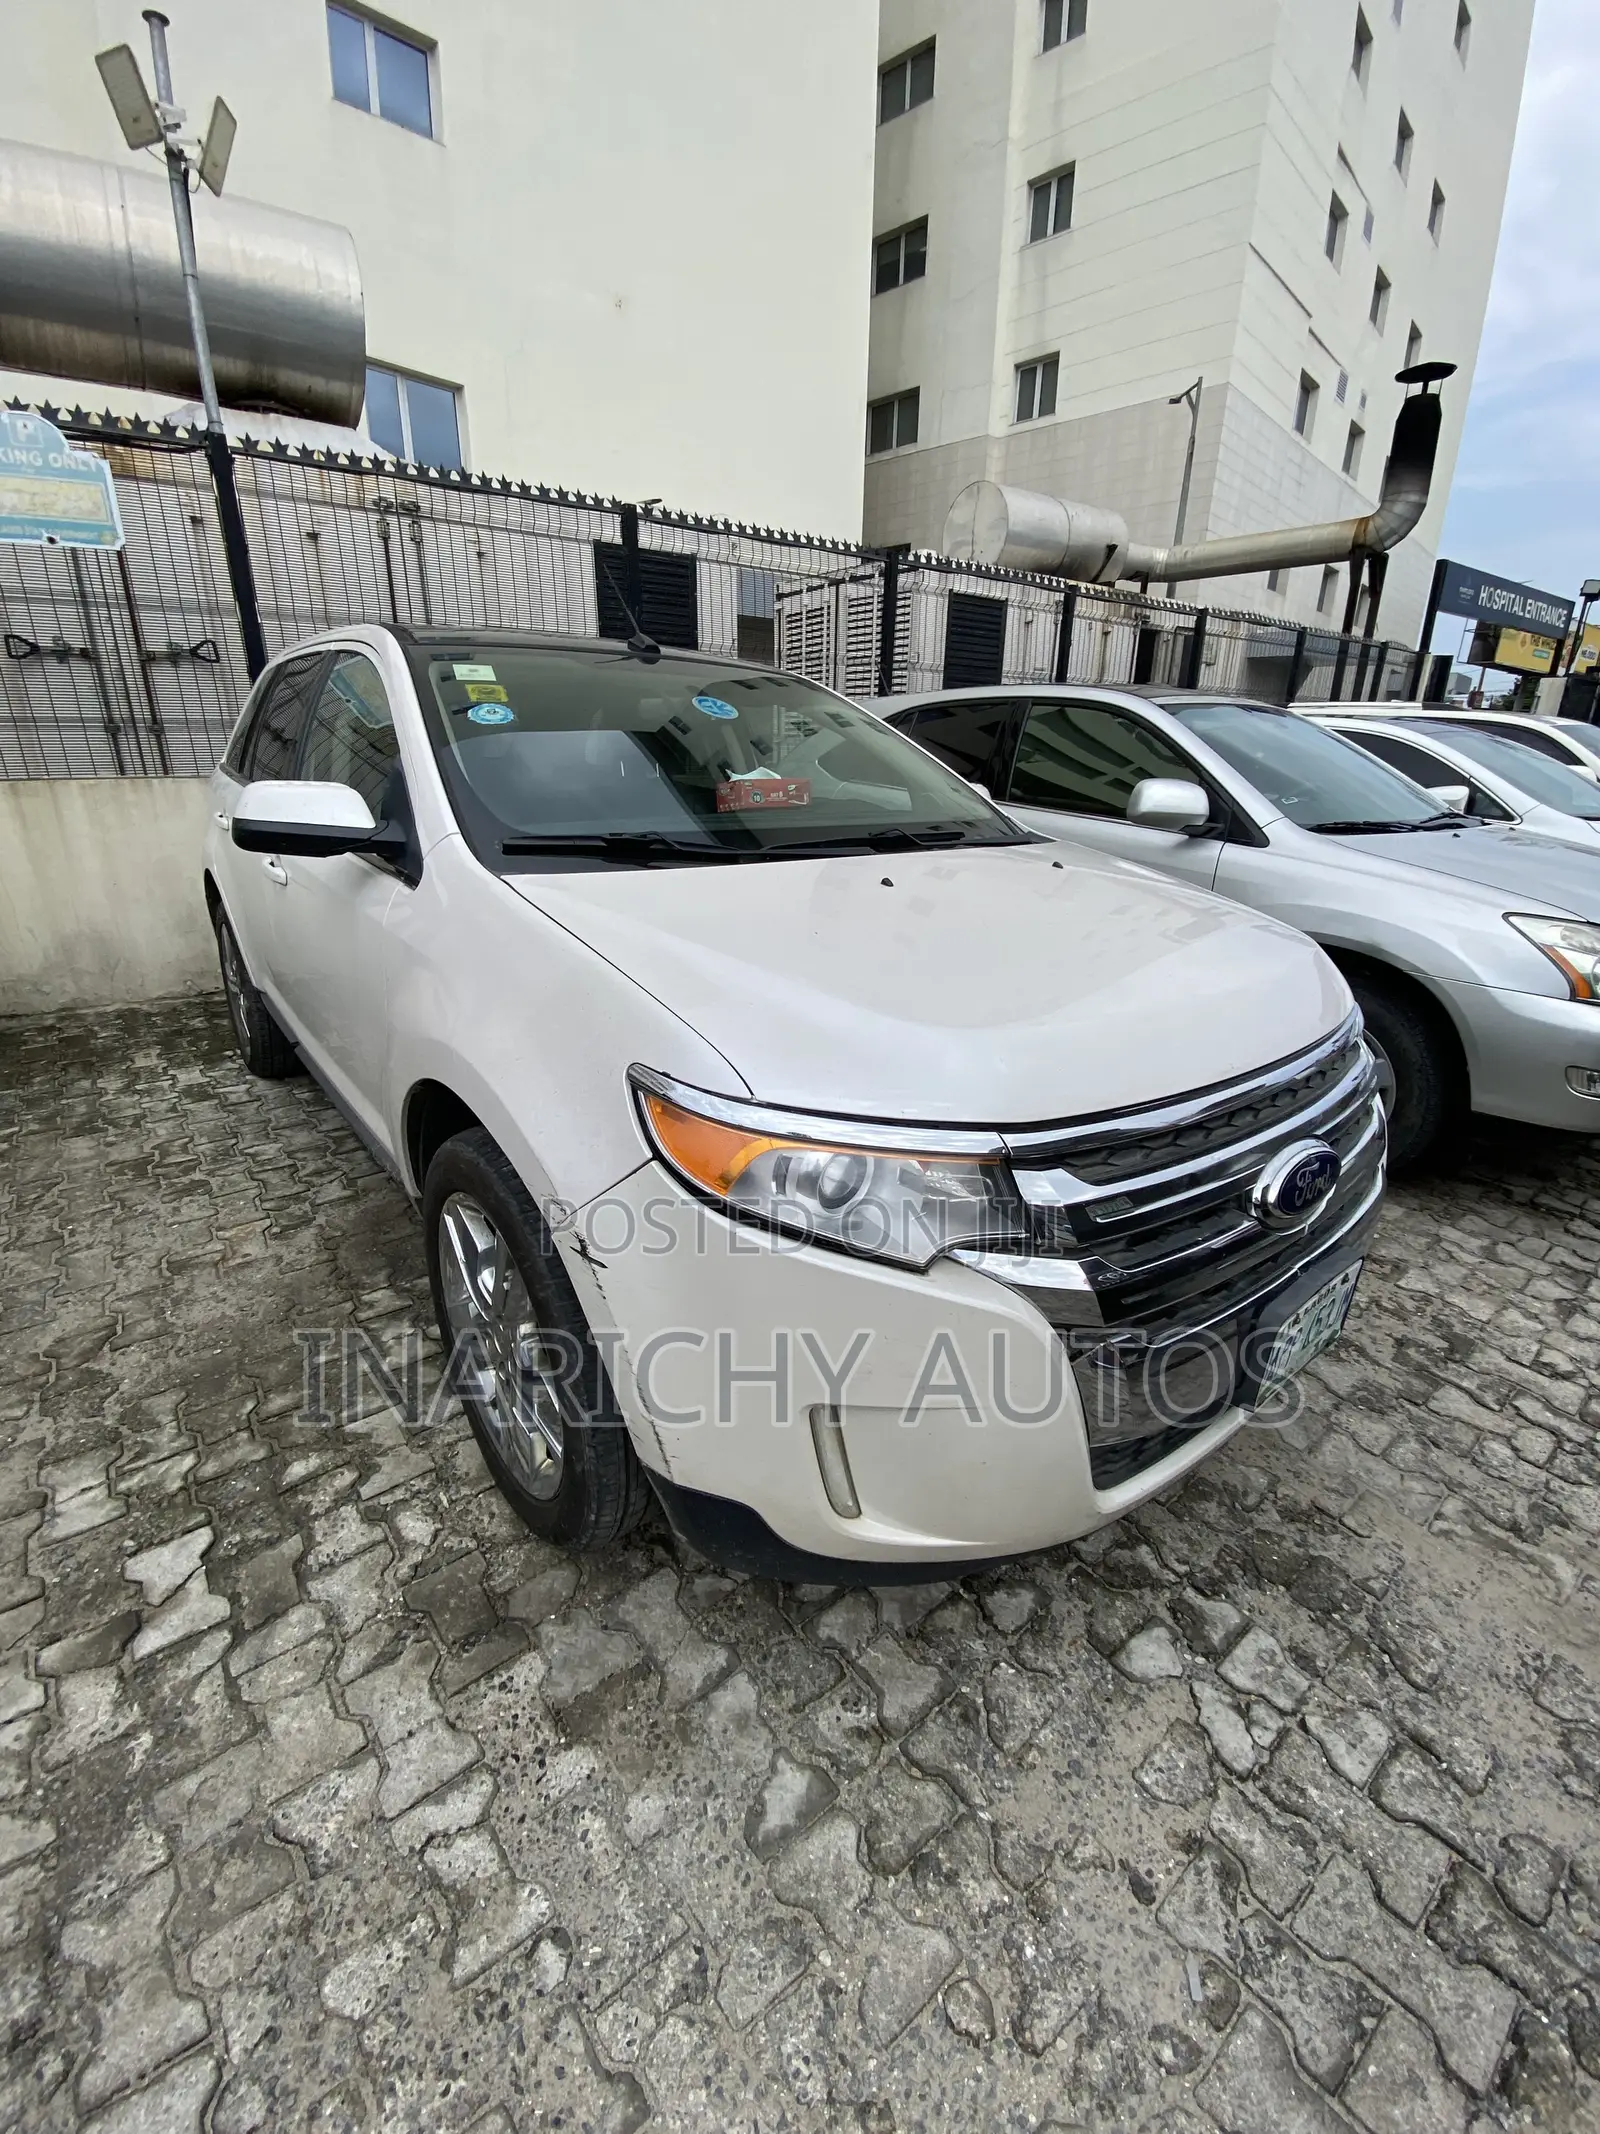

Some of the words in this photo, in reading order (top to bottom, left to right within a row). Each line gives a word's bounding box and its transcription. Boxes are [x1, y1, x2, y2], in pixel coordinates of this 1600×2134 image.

[1478, 585, 1524, 616] HOSPITAL
[1524, 598, 1567, 628] ENTRANCE
[1295, 1162, 1331, 1206] Ford
